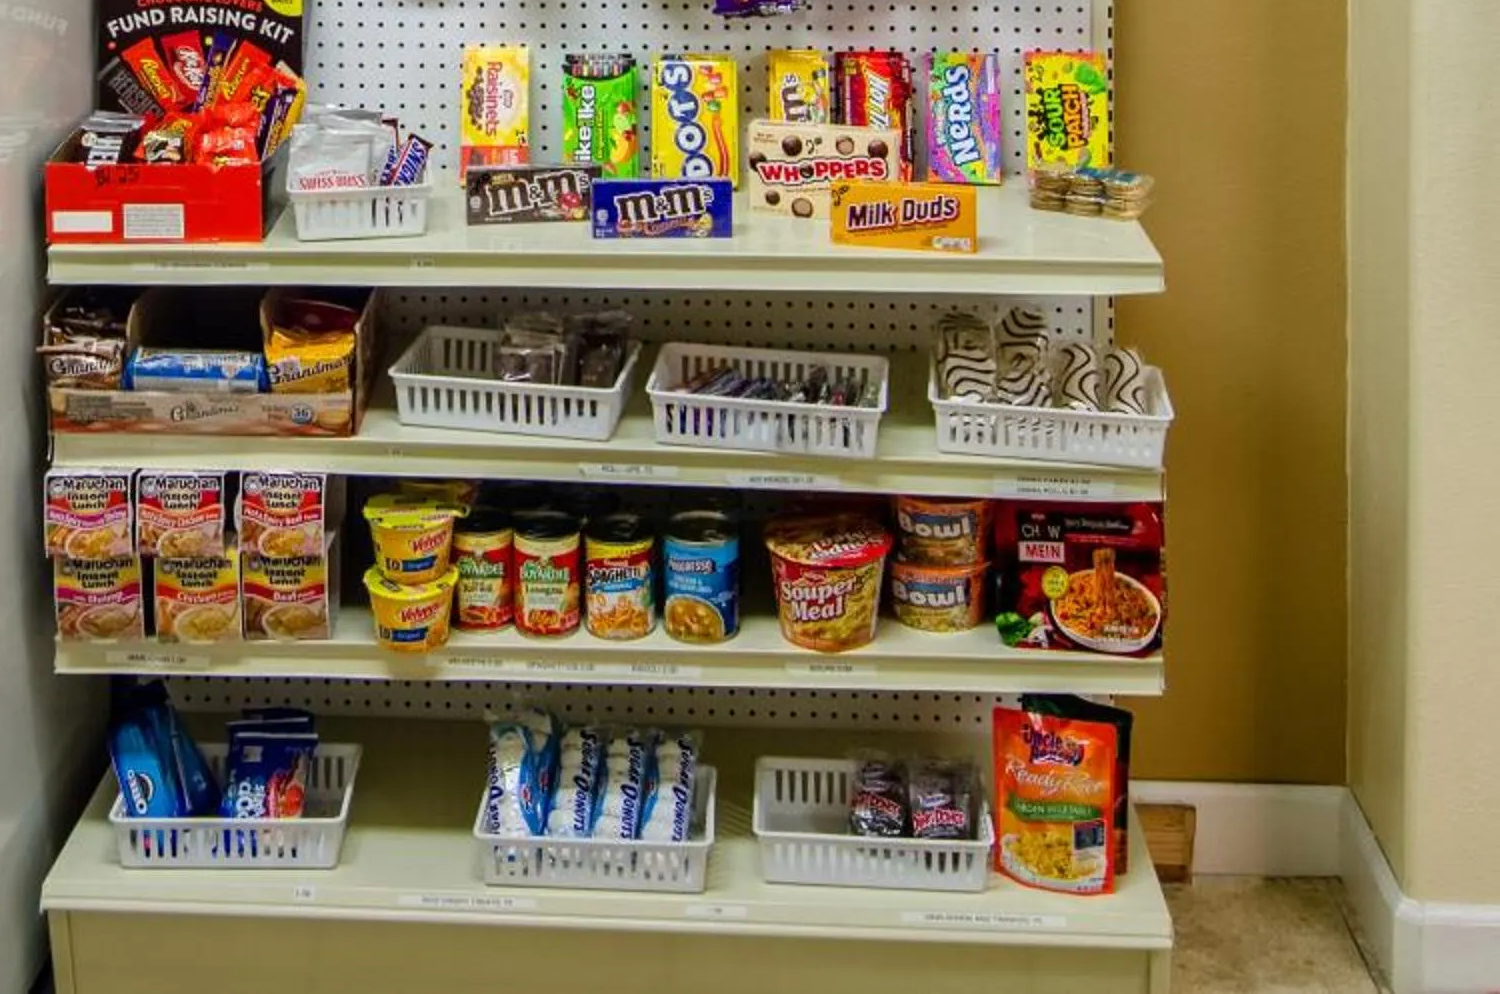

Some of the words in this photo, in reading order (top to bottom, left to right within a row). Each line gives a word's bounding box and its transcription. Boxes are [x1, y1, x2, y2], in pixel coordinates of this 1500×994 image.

[106, 9, 165, 39] FUND
[170, 6, 257, 31] RAISING
[259, 18, 295, 44] KIT
[485, 61, 503, 137] Raisinets
[661, 62, 714, 178] DOTS
[1045, 87, 1066, 148] SOUR
[1063, 84, 1087, 149] PATCH
[848, 203, 894, 228] Milk
[902, 195, 957, 223] Duds
[63, 478, 124, 490] Maruchan
[155, 478, 219, 490] Maruchan
[260, 476, 320, 490] Maruchan
[900, 510, 971, 538] Bowl
[73, 558, 133, 569] Maruchan
[1025, 544, 1061, 557] MEIN
[781, 579, 855, 605] Souper
[893, 582, 965, 606] Bowl
[790, 598, 843, 622] Meal
[1005, 756, 1062, 796] Ready
[573, 775, 589, 832] DONUTS
[621, 783, 638, 839] DONUTS
[672, 784, 688, 842] DONUTS
